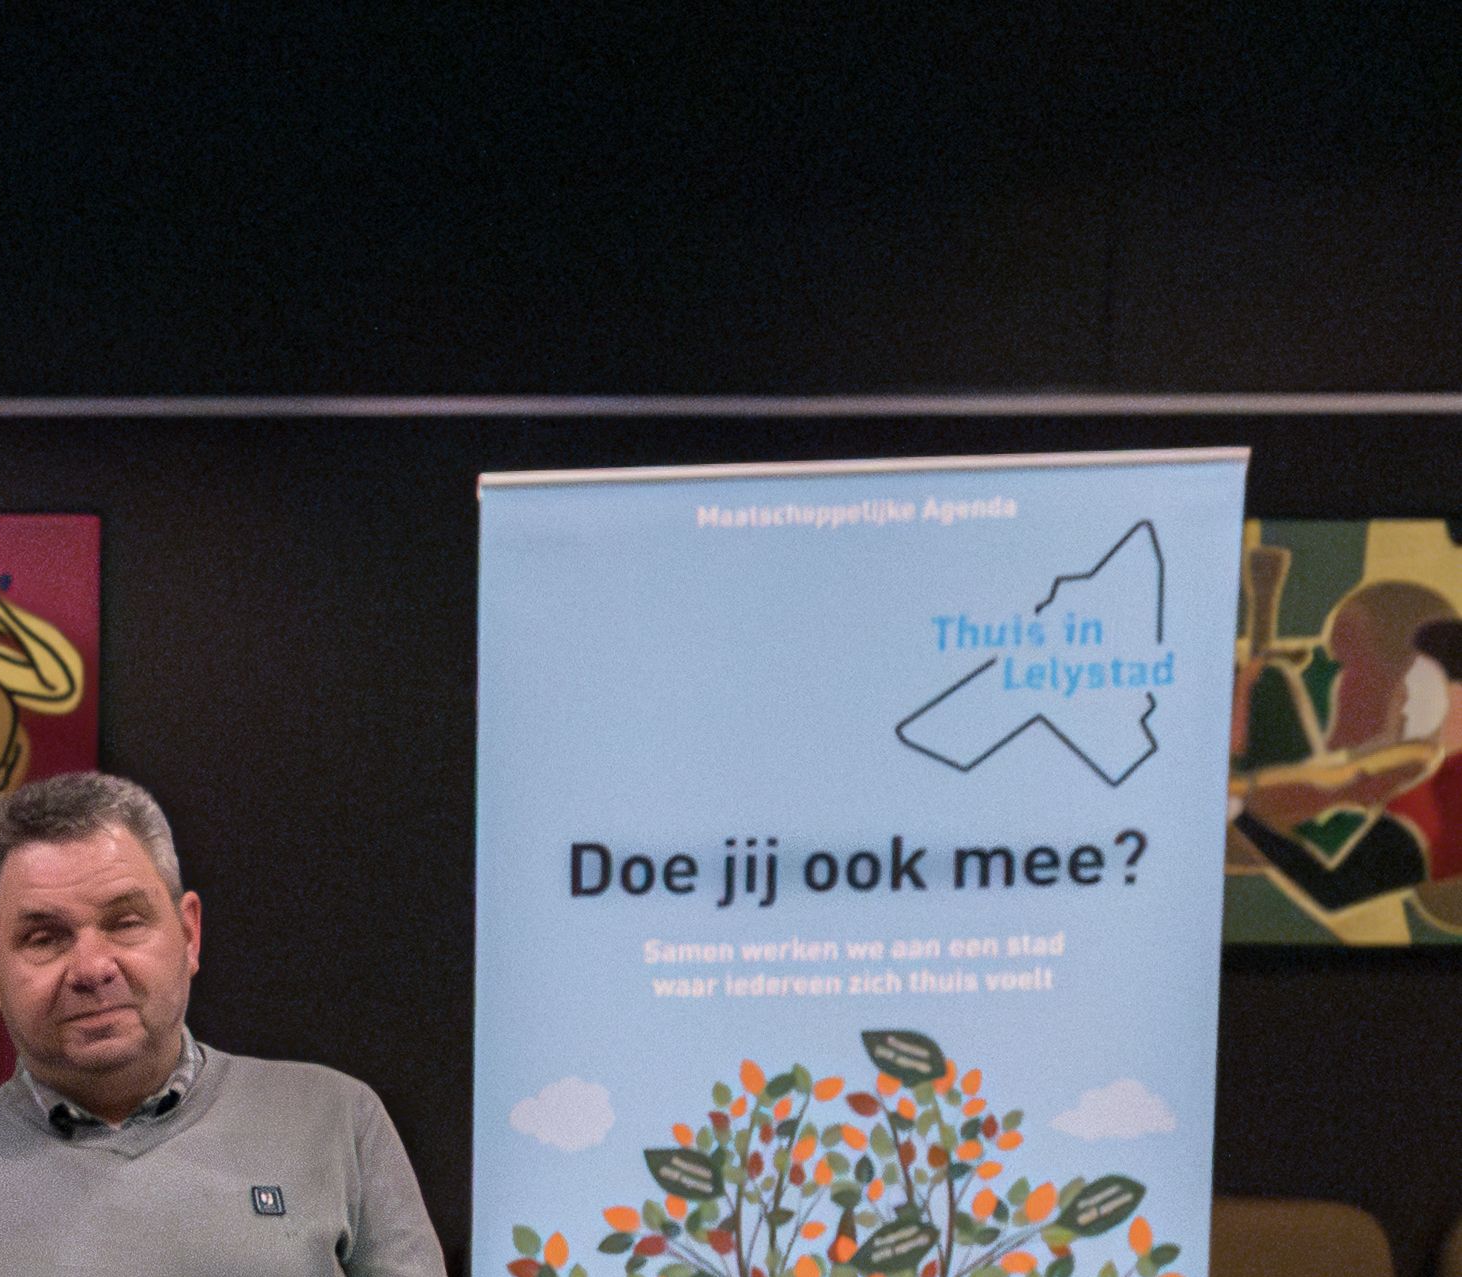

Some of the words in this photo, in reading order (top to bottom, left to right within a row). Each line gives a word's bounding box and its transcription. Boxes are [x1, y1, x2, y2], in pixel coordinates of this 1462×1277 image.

[923, 496, 1017, 525] Agenda
[931, 616, 1045, 652] Thuis
[1064, 612, 1103, 646] in
[1002, 652, 1175, 697] Lelystad
[569, 841, 698, 897] Doe
[717, 837, 779, 907] jij
[803, 835, 927, 893] ook
[953, 828, 1149, 889] mee?
[643, 938, 733, 963] Samen
[742, 936, 839, 961] werken
[847, 941, 886, 960] we
[890, 938, 940, 959] aan
[949, 936, 999, 958] een
[1007, 931, 1065, 957] stad
[652, 975, 718, 997] waar
[726, 972, 841, 997] iedereen
[848, 968, 902, 994] zich
[909, 968, 979, 993] thuis
